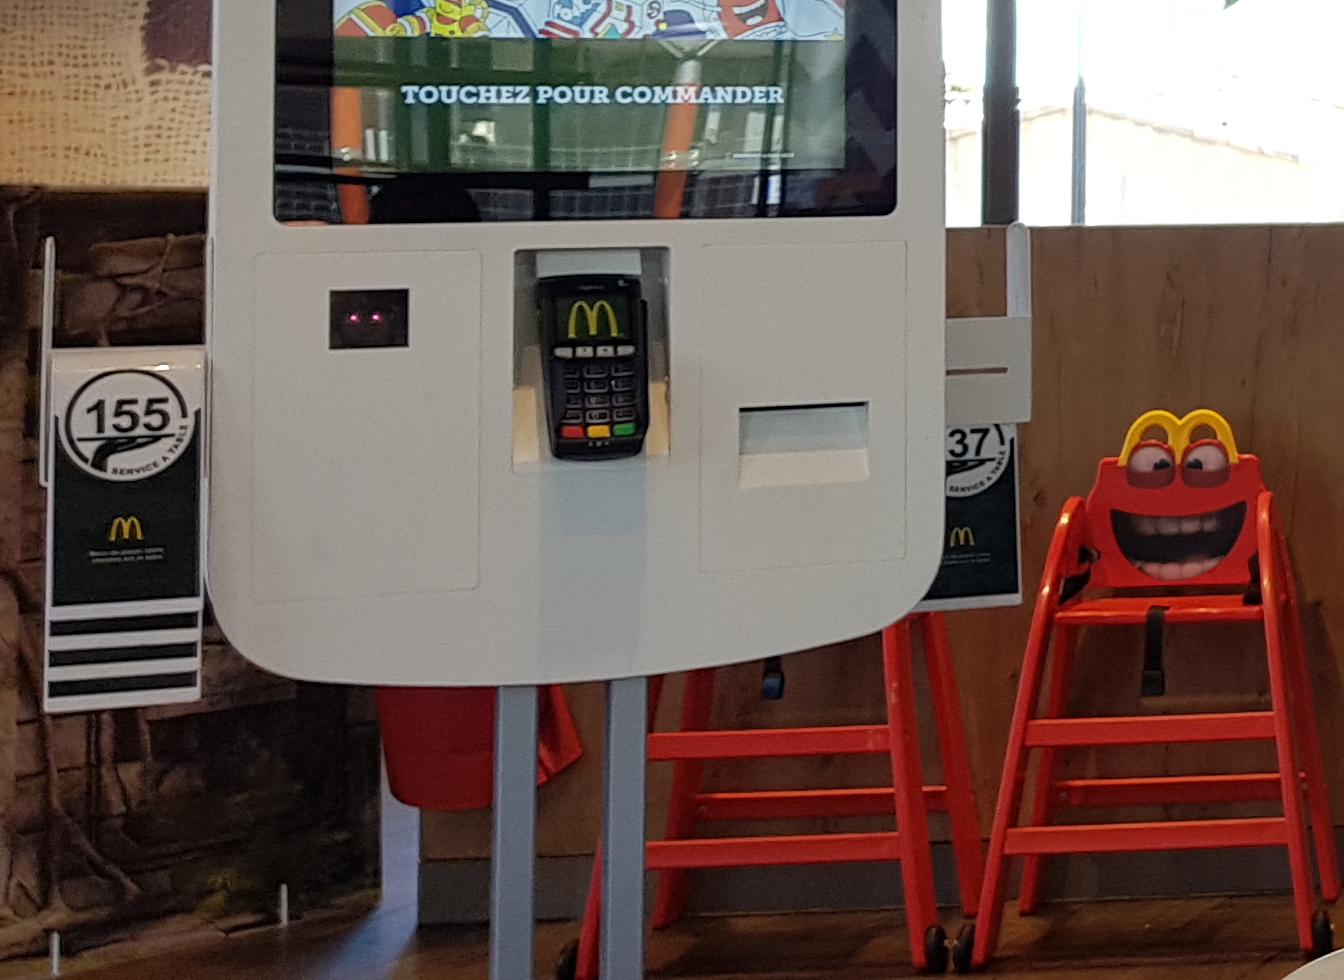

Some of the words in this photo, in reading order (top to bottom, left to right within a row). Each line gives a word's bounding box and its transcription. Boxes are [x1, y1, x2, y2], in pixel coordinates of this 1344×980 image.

[401, 84, 530, 104] TOUCHEZ
[536, 85, 610, 105] POUR
[615, 85, 785, 106] COMMANDER
[86, 396, 171, 435] 155
[111, 460, 161, 476] SERVICE
[168, 424, 189, 454] TABLE
[948, 428, 991, 458] 37
